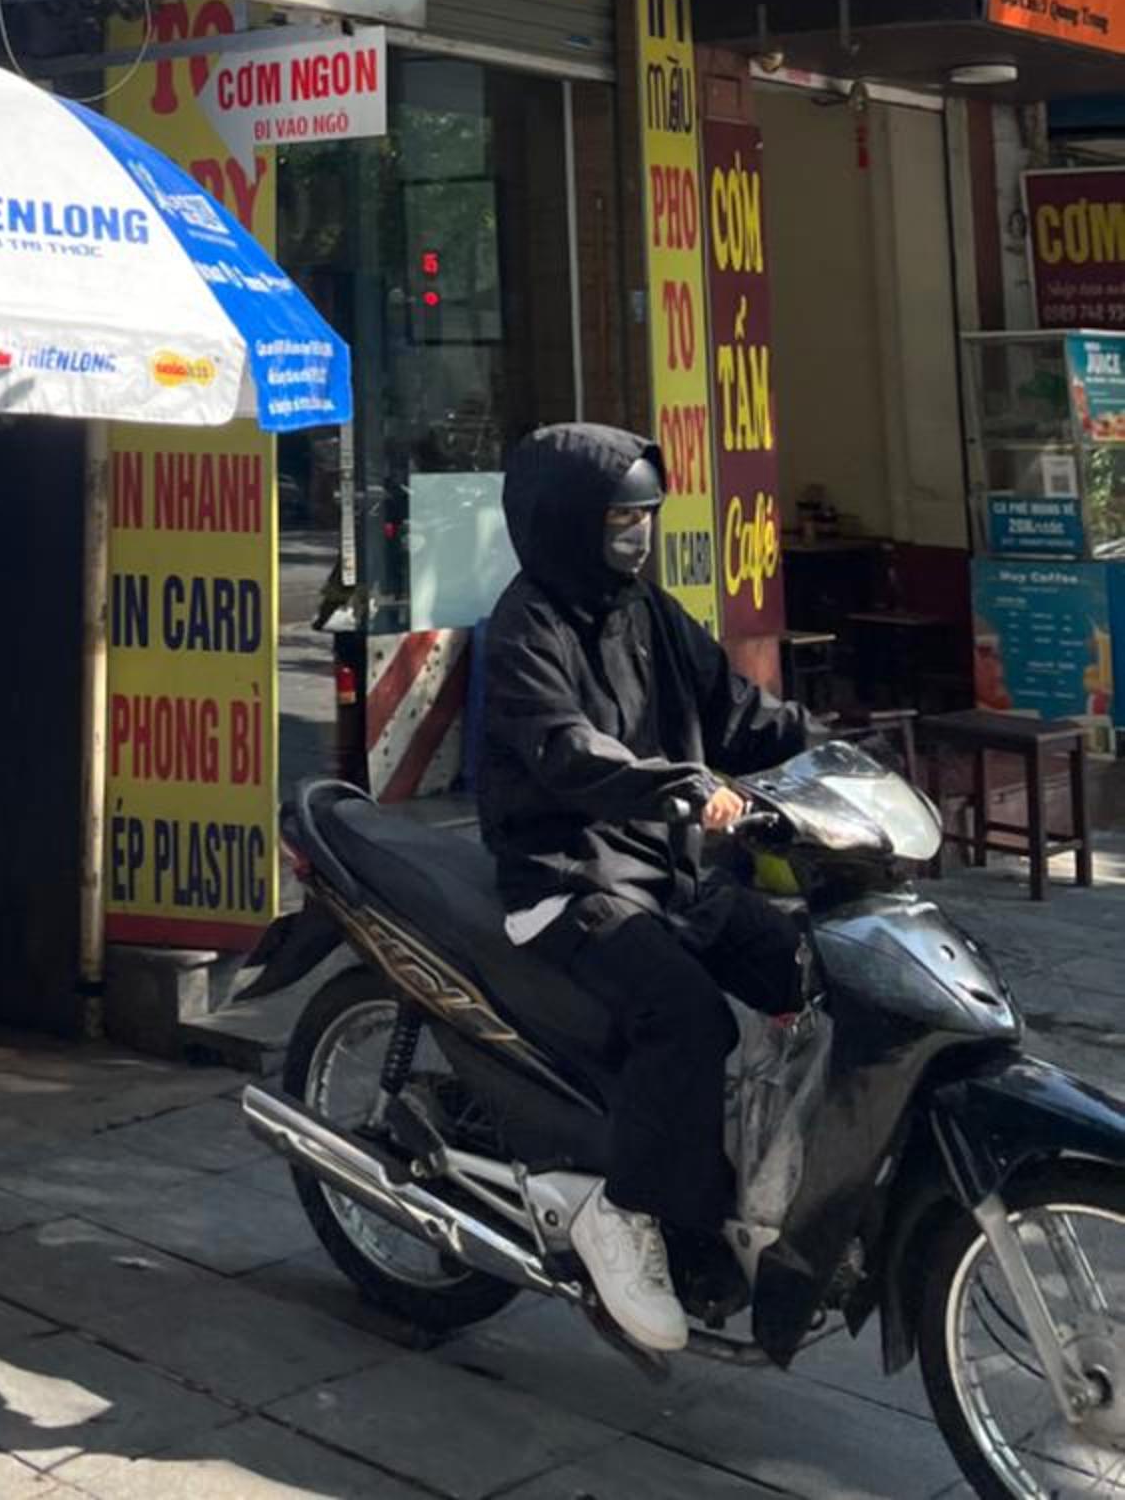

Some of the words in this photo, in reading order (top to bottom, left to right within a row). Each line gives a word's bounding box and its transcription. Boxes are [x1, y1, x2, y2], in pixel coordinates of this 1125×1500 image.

[218, 61, 282, 112] CƠM
[290, 47, 378, 102] NGON
[650, 164, 698, 251] PHO
[711, 151, 764, 273] CƠM
[1036, 198, 1125, 264] CƠM
[663, 280, 695, 372] TO
[112, 451, 143, 531] IN
[153, 452, 263, 534] NHANH
[660, 403, 707, 496] COPY
[726, 491, 779, 612] Café
[112, 575, 149, 650] IN
[162, 575, 263, 655] CARD
[111, 693, 220, 785] PHONG
[230, 681, 262, 787] BÌ
[112, 798, 145, 902] ÉP
[153, 818, 266, 914] PLASTIC
